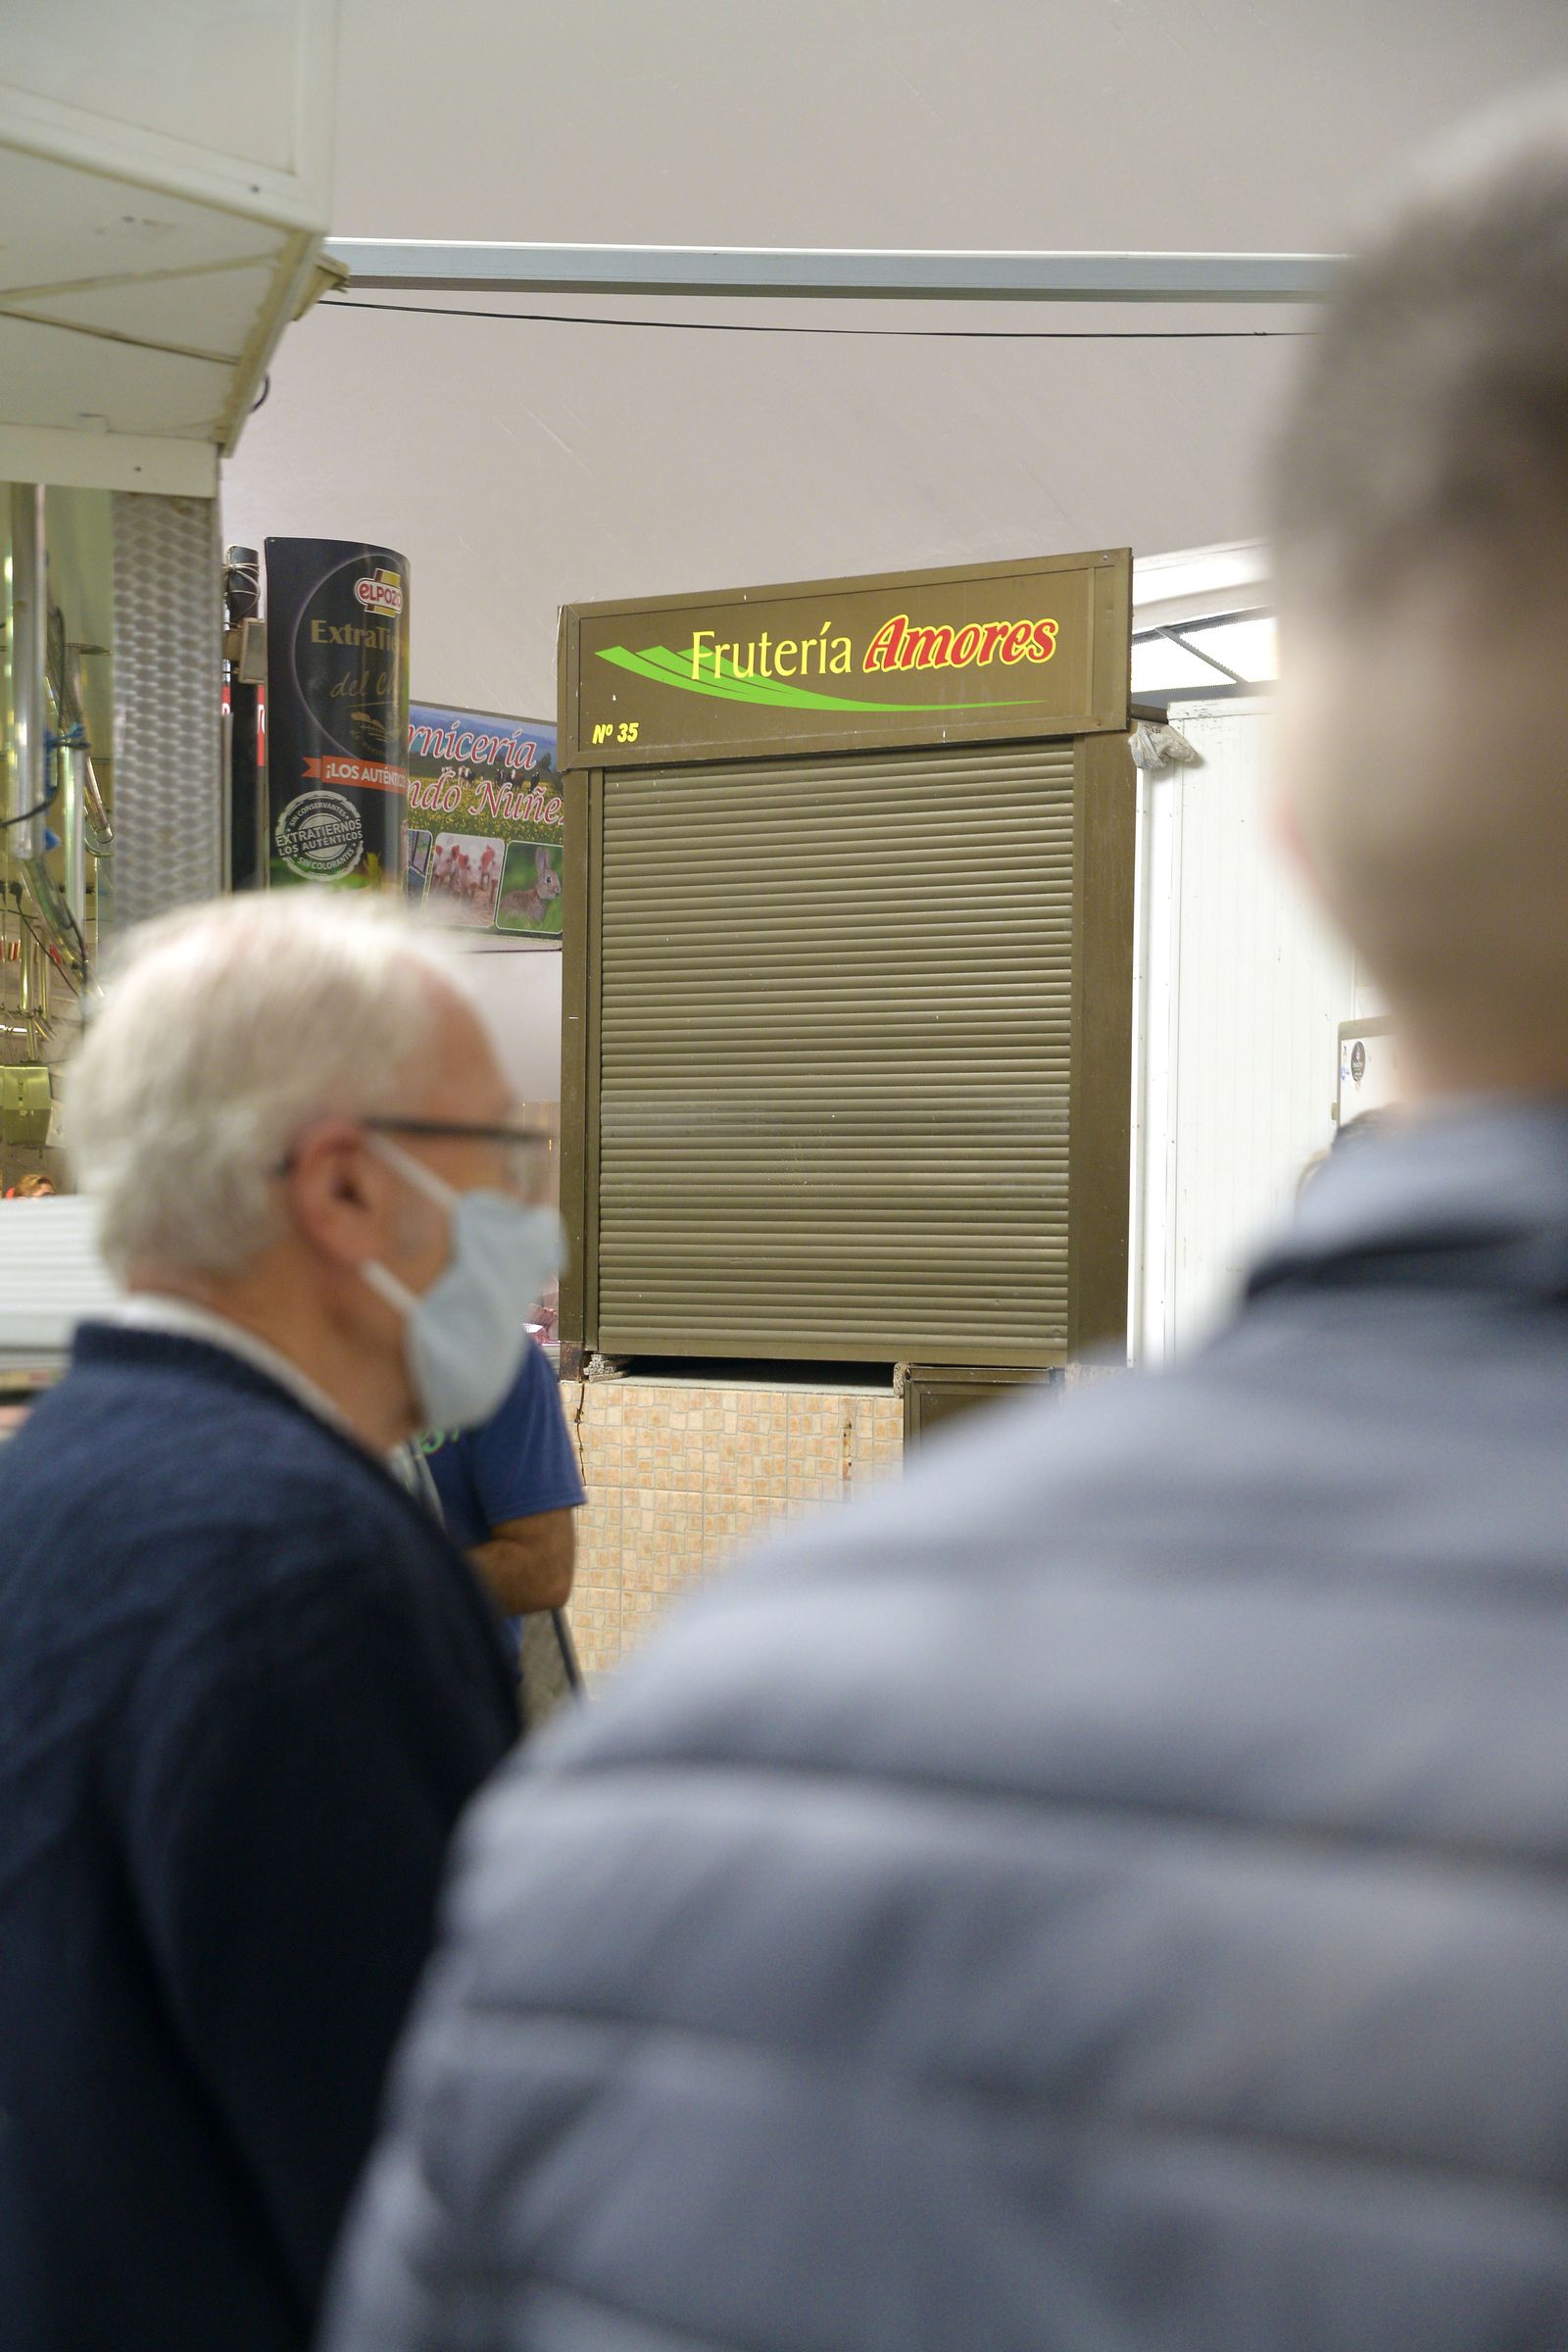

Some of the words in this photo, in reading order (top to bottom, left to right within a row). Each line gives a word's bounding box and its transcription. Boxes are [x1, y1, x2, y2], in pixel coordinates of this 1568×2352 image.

[691, 621, 852, 680] Frutería
[861, 613, 1059, 673] Amores
[616, 722, 639, 743] 35
[408, 720, 537, 771] rnicería
[325, 762, 360, 780] ¡LOS
[408, 769, 462, 812] ndo
[297, 802, 347, 818] CONSERVANTES
[274, 818, 363, 848] EXTRATIERNOS
[278, 844, 299, 857] LOS
[313, 848, 355, 870] COLORANTES
